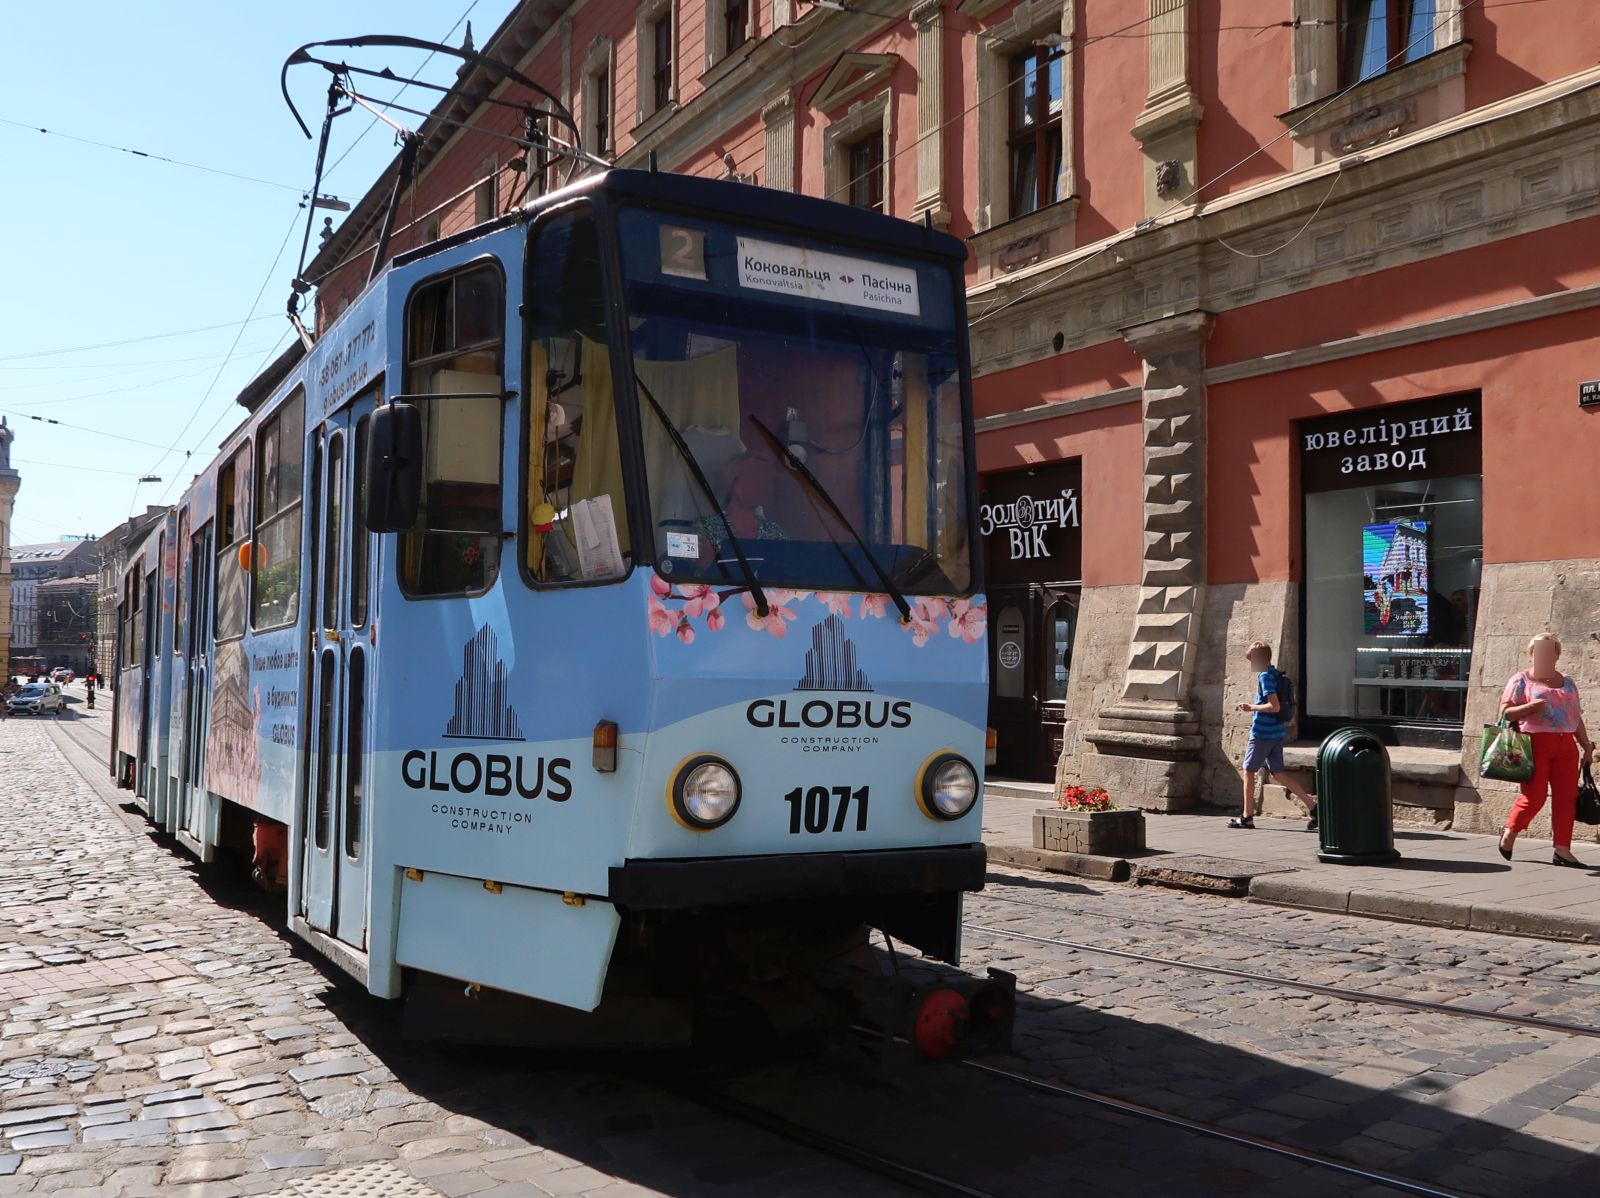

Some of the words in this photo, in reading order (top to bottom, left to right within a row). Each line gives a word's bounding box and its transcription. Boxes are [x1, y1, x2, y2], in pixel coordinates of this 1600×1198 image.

[671, 230, 696, 266] 2
[744, 256, 831, 283] Коновальця
[861, 274, 912, 294] Пасічна
[745, 274, 803, 290] Konovaltsia
[863, 291, 902, 305] Pasichna
[1305, 407, 1472, 451] ювелірний
[1341, 448, 1427, 474] завод
[1008, 524, 1051, 560] ВІК
[746, 699, 912, 730] GLOBUS
[780, 736, 880, 746] CONSTRUCTION
[801, 744, 864, 754] COMPANY
[401, 748, 573, 803] GLOBUS
[430, 803, 533, 824] CONSTRUCTION
[784, 785, 869, 834] 1071
[450, 818, 513, 835] COMPANY
